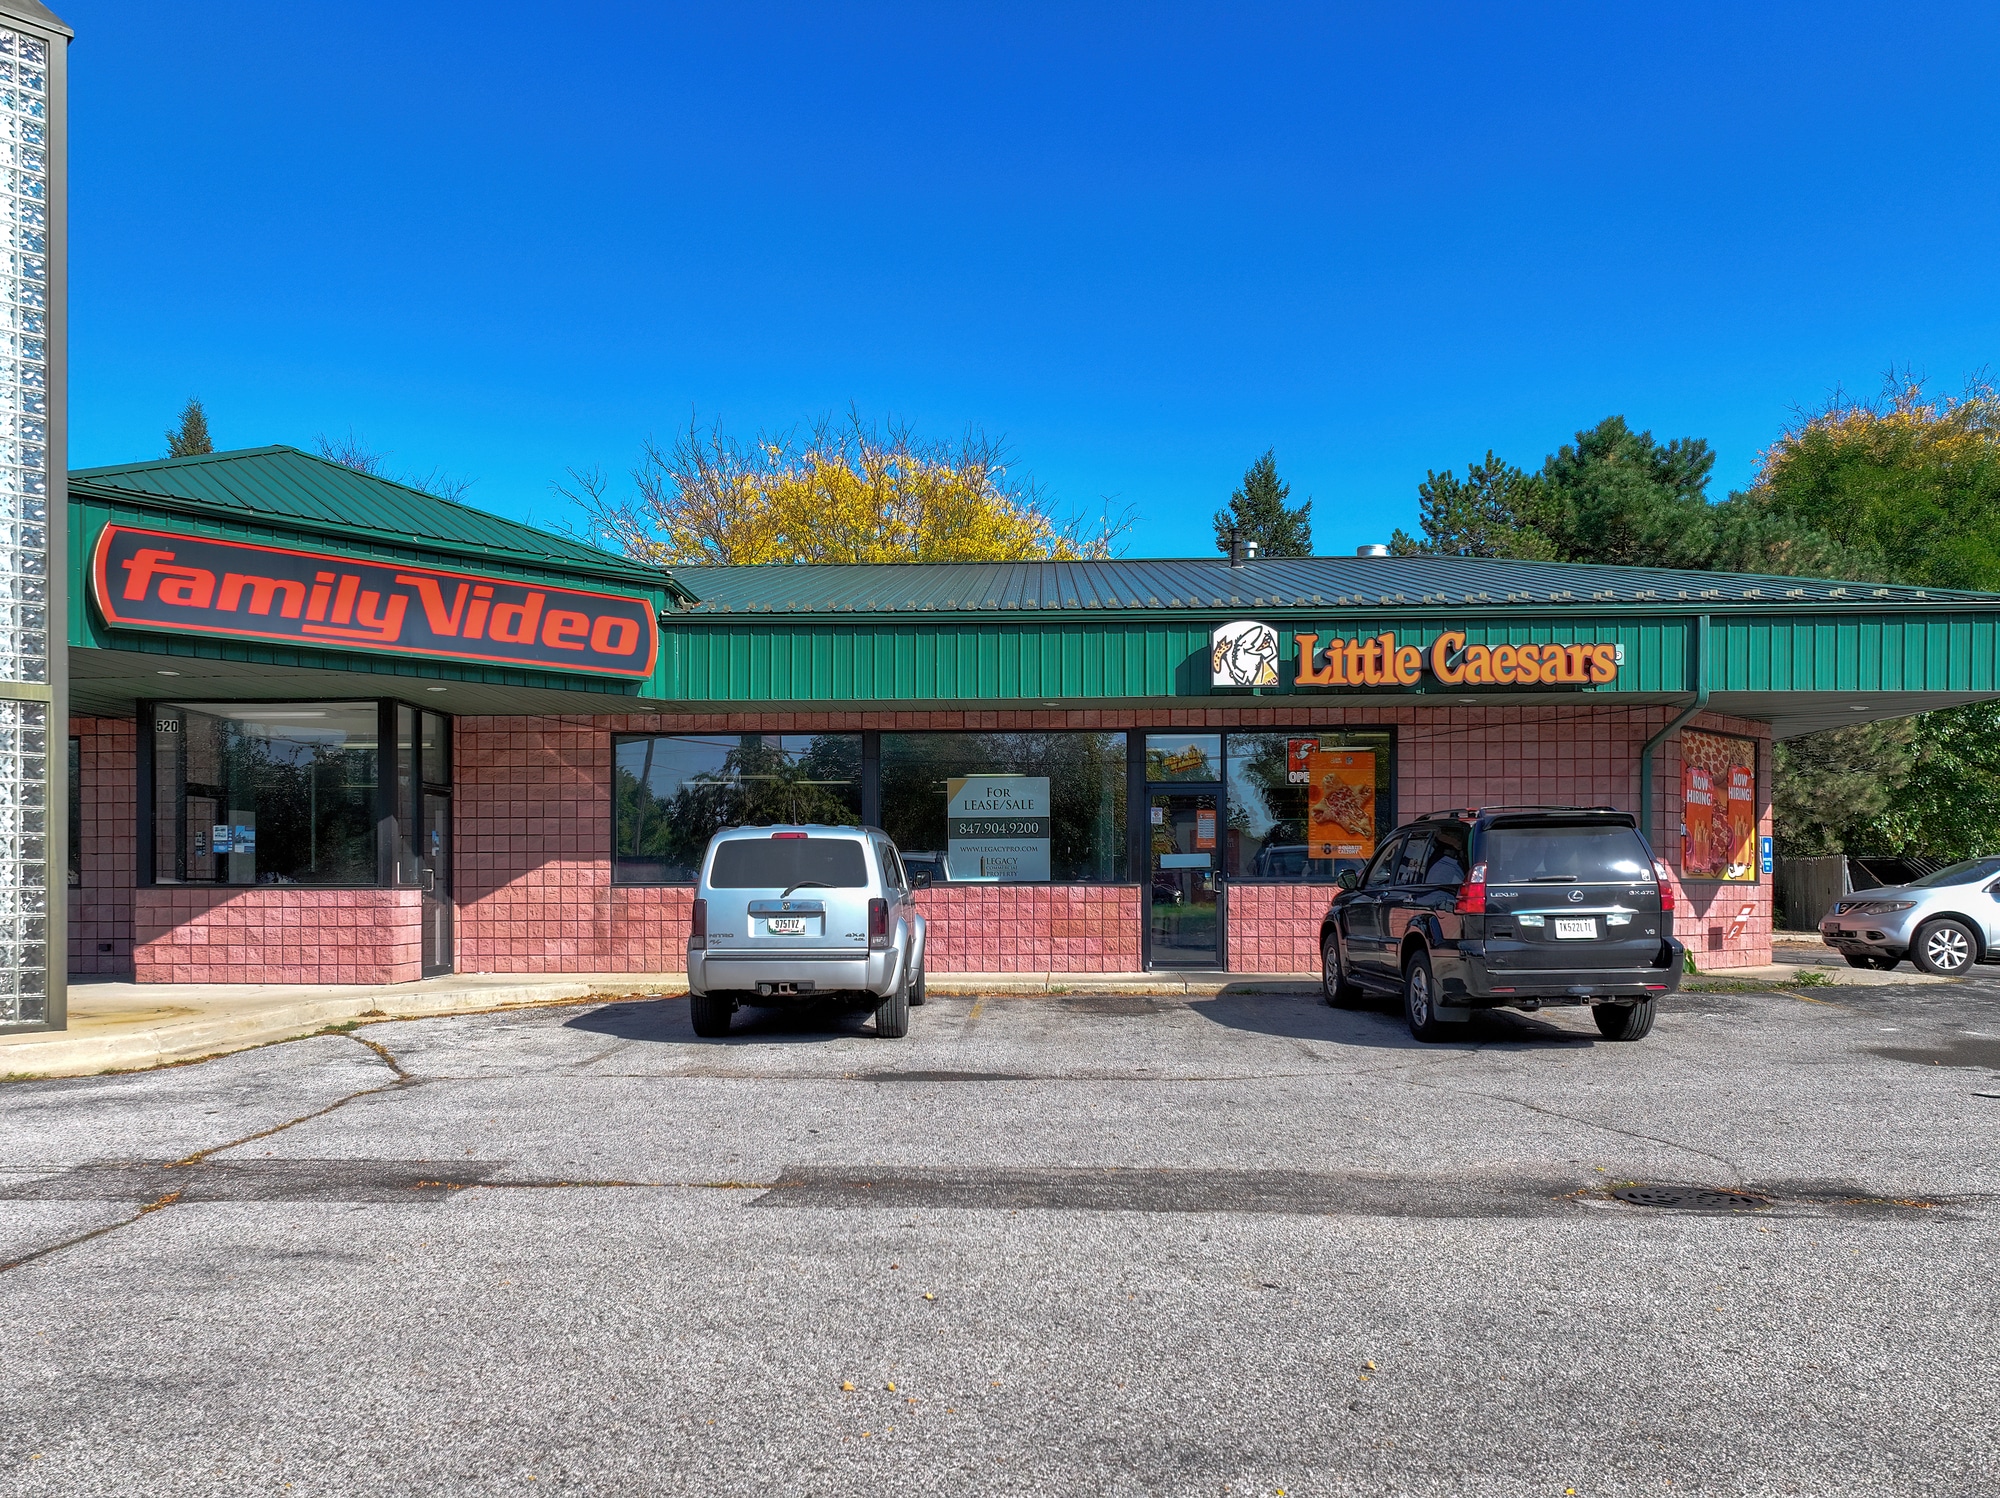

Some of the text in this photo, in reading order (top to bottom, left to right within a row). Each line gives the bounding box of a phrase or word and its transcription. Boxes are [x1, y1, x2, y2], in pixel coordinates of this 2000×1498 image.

[122, 548, 640, 656] family Video
[1293, 630, 1618, 687] Little Caesars
[156, 720, 178, 732] 520
[1288, 771, 1310, 783] OPE
[1692, 775, 1709, 791] NOW
[1732, 773, 1748, 787] NOW
[986, 787, 1012, 798] FOR
[1686, 789, 1713, 807] HIRING!
[1728, 786, 1752, 802] HIRING!
[964, 799, 1035, 811] LEASE/SALE
[959, 822, 1039, 835] 847.904.9200
[960, 845, 1039, 853] WWW.LEGACYPRO.COM
[986, 857, 1018, 865] LEGACY
[774, 919, 800, 929] 975TVZ
[1559, 922, 1593, 933] TK522LTL
